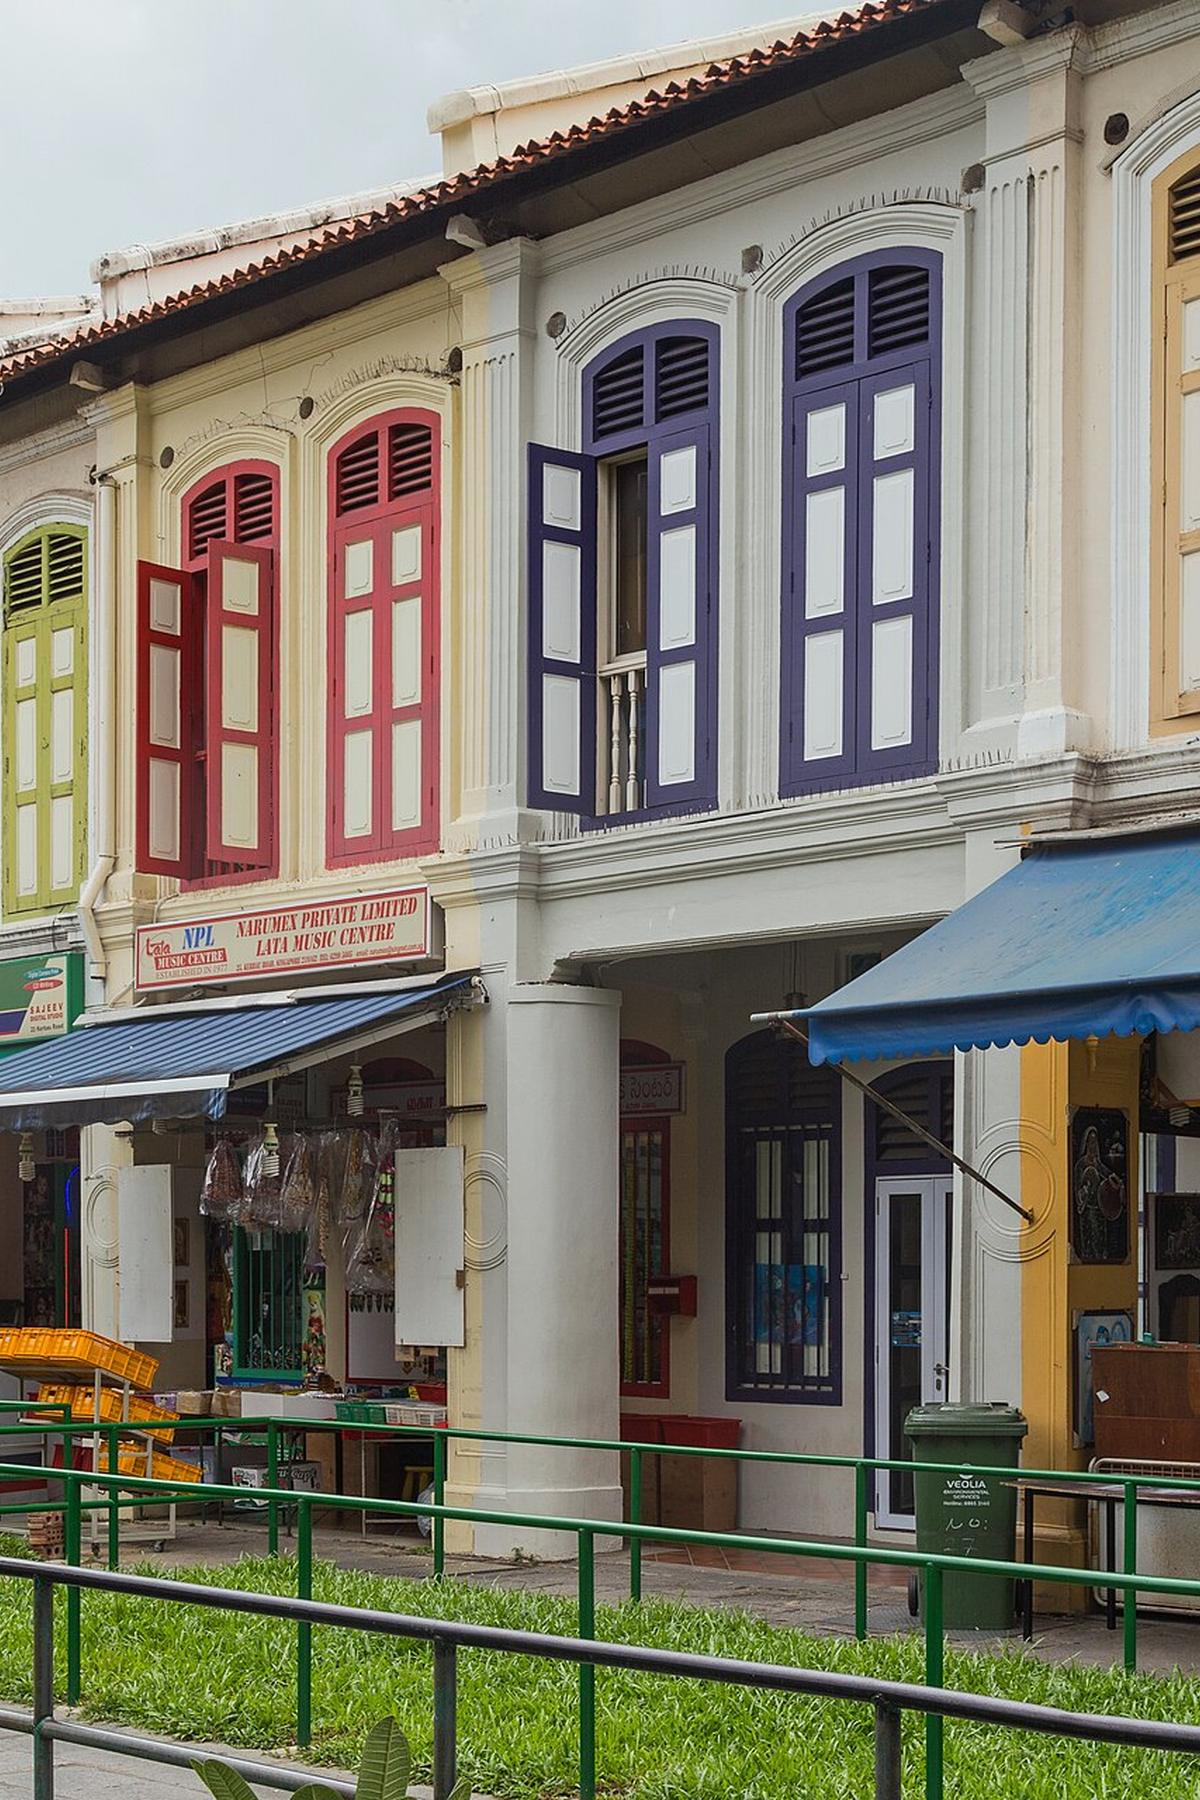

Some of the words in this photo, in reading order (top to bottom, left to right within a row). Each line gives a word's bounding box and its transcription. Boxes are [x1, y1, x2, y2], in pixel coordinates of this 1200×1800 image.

[236, 913, 298, 938] NARUMEX
[301, 905, 357, 929] PRIVATE
[360, 897, 418, 921] LIMITED
[183, 925, 214, 949] NPL
[256, 936, 289, 957] LATA
[292, 930, 336, 952] MUSIC
[339, 922, 396, 946] CENTRE
[157, 954, 187, 969] MUSIC
[188, 950, 225, 965] CENTRE
[30, 1003, 64, 1014] SAJEEV
[947, 1480, 986, 1489] VEOLIA
